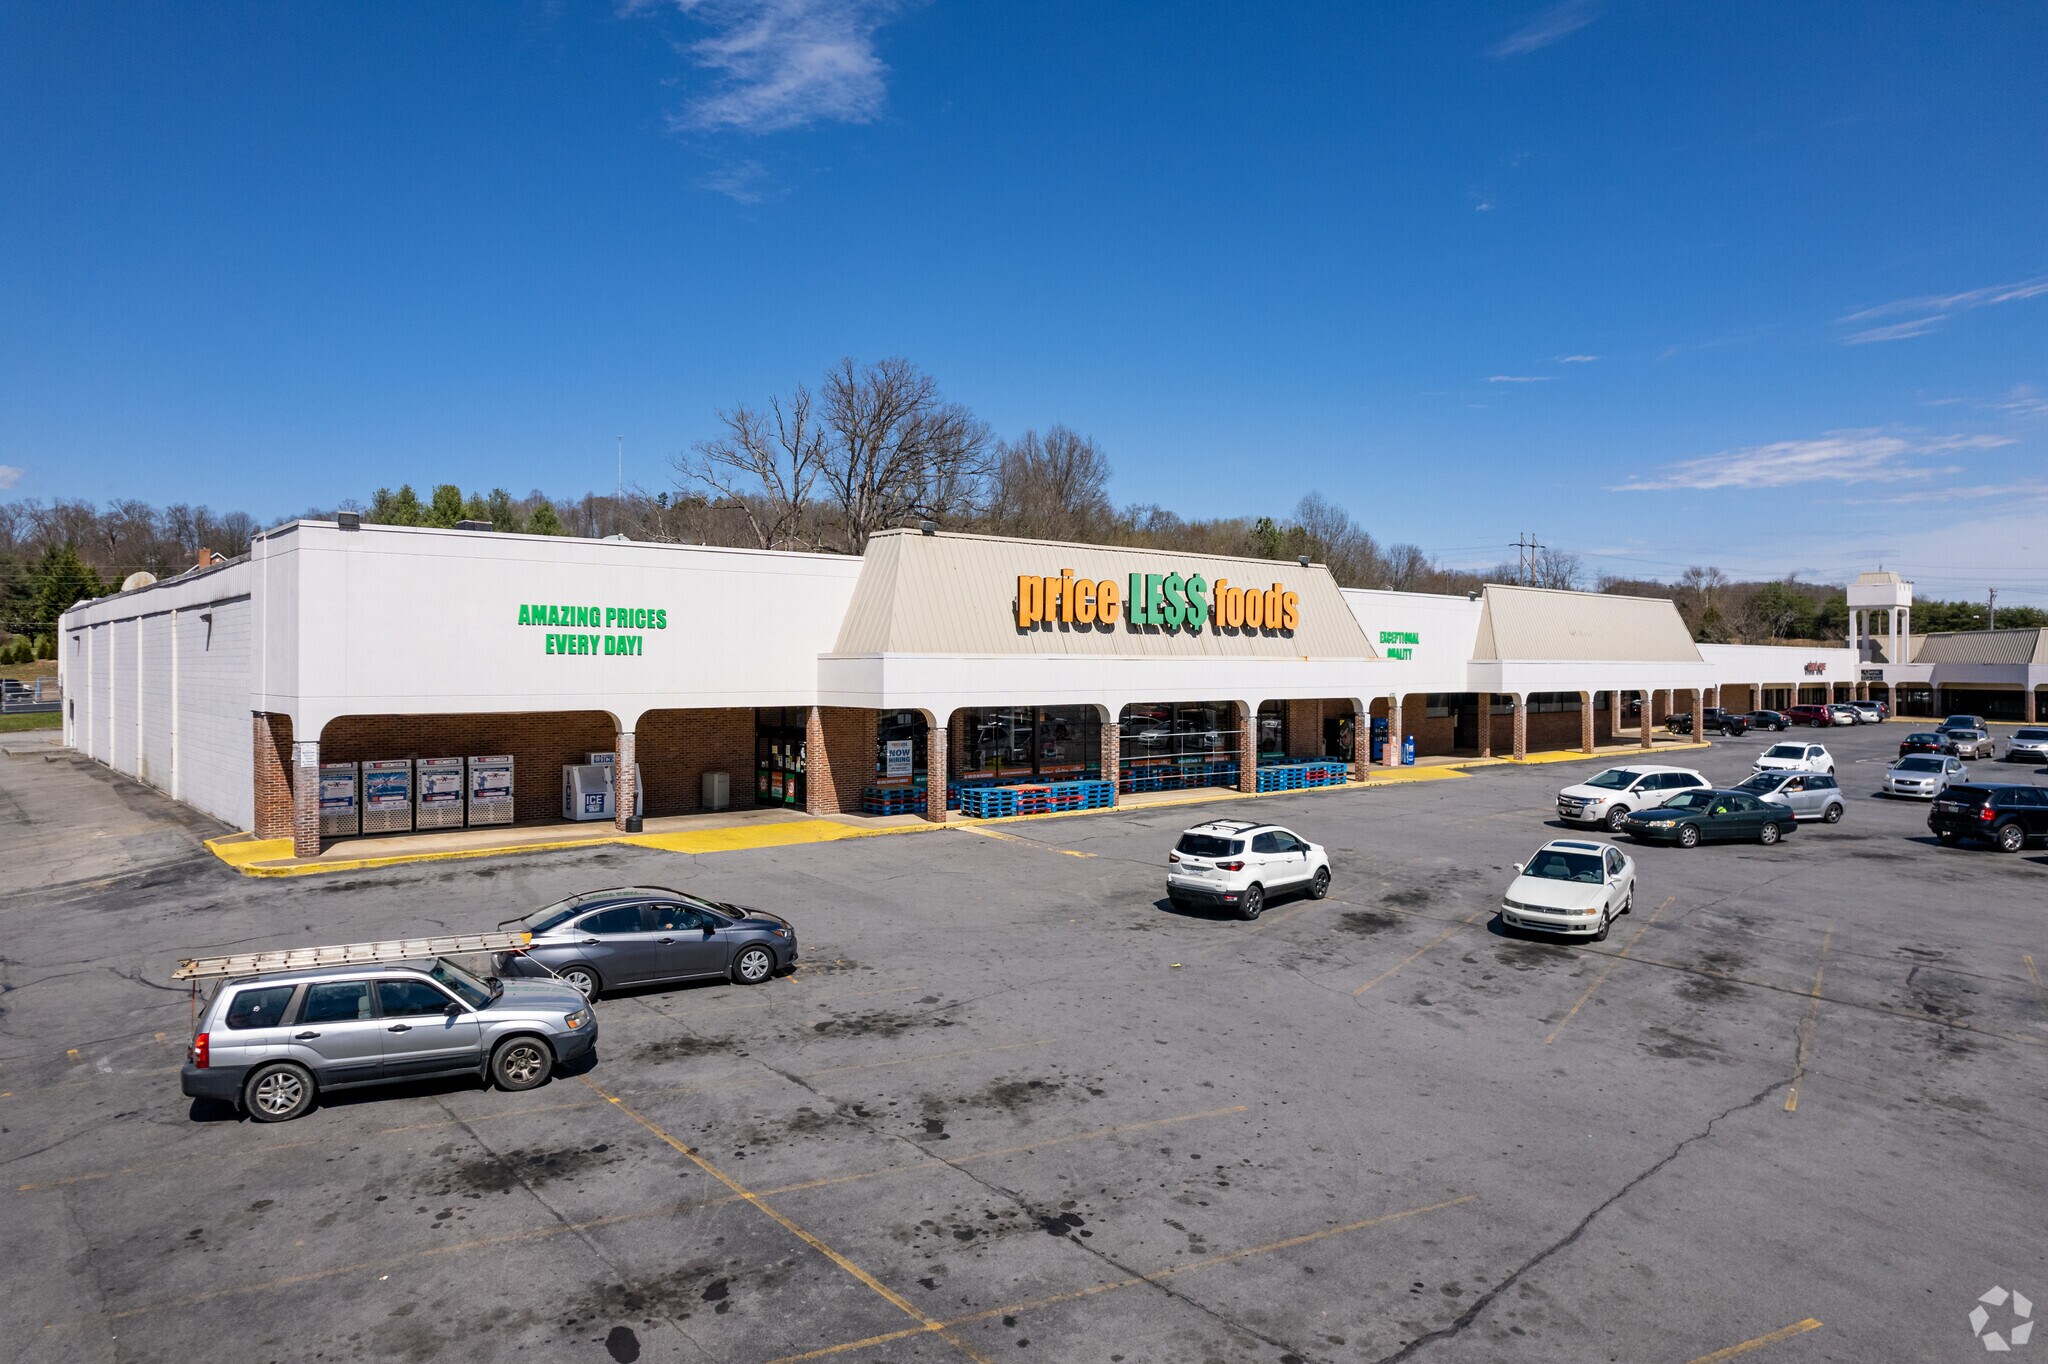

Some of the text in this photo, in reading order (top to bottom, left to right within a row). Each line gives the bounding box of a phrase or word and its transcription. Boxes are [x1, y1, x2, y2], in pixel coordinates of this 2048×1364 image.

[1017, 568, 1300, 631] price LE$$ foods
[517, 603, 669, 630] AMAZING PRICES
[545, 633, 643, 656] EVERY DAY!
[586, 795, 603, 805] ICE
